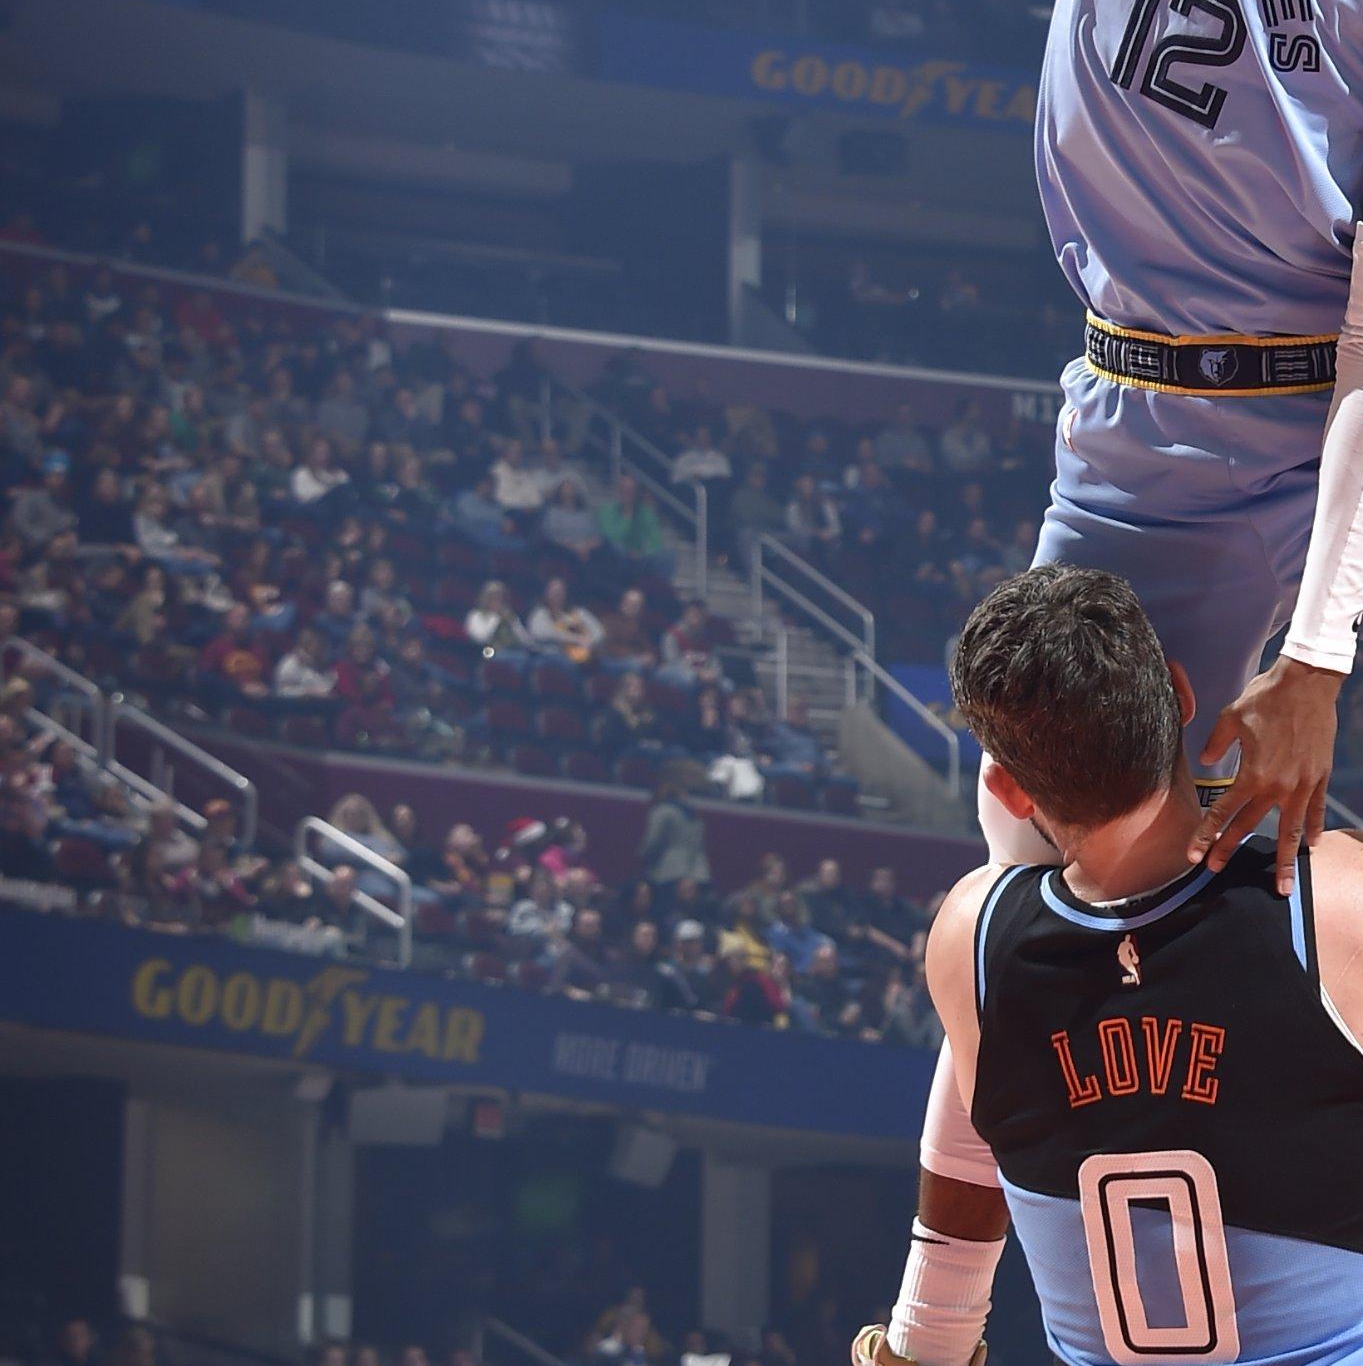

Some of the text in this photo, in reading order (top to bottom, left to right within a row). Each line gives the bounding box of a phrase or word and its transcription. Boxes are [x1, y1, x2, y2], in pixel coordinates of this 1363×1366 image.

[752, 50, 1037, 123] GOODYEA
[132, 956, 486, 1065] GOODYEAR
[1050, 1016, 1227, 1109] LOVE
